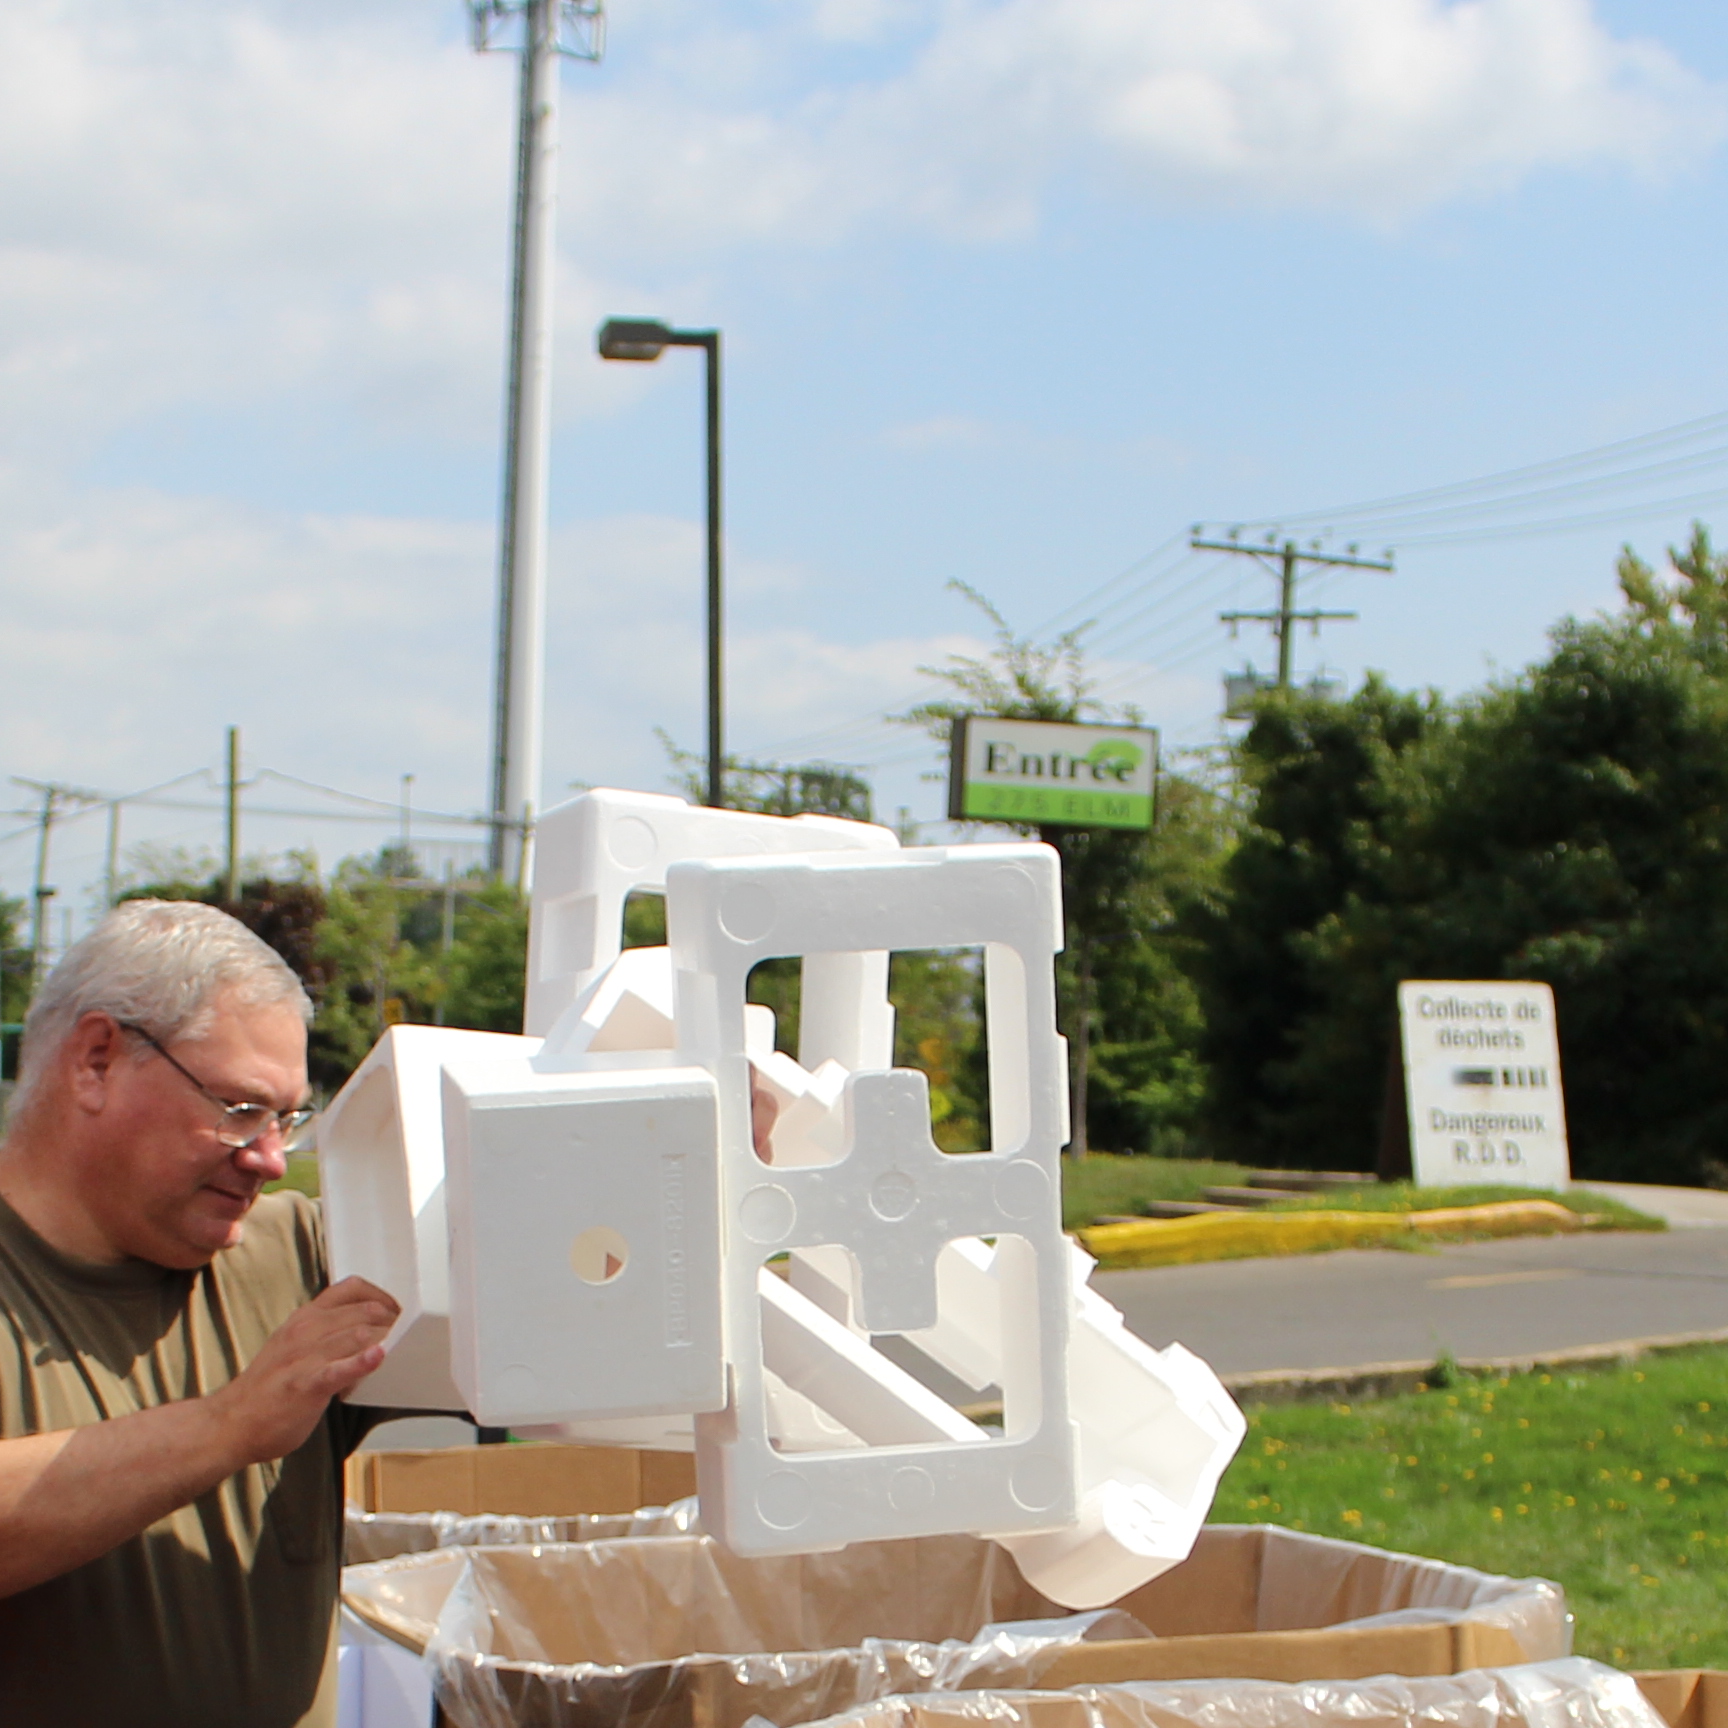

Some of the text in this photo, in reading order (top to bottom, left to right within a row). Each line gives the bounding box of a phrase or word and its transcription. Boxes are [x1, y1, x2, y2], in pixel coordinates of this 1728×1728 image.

[1417, 995, 1541, 1020] Collecte de
[1430, 1108, 1546, 1134] Dangereux
